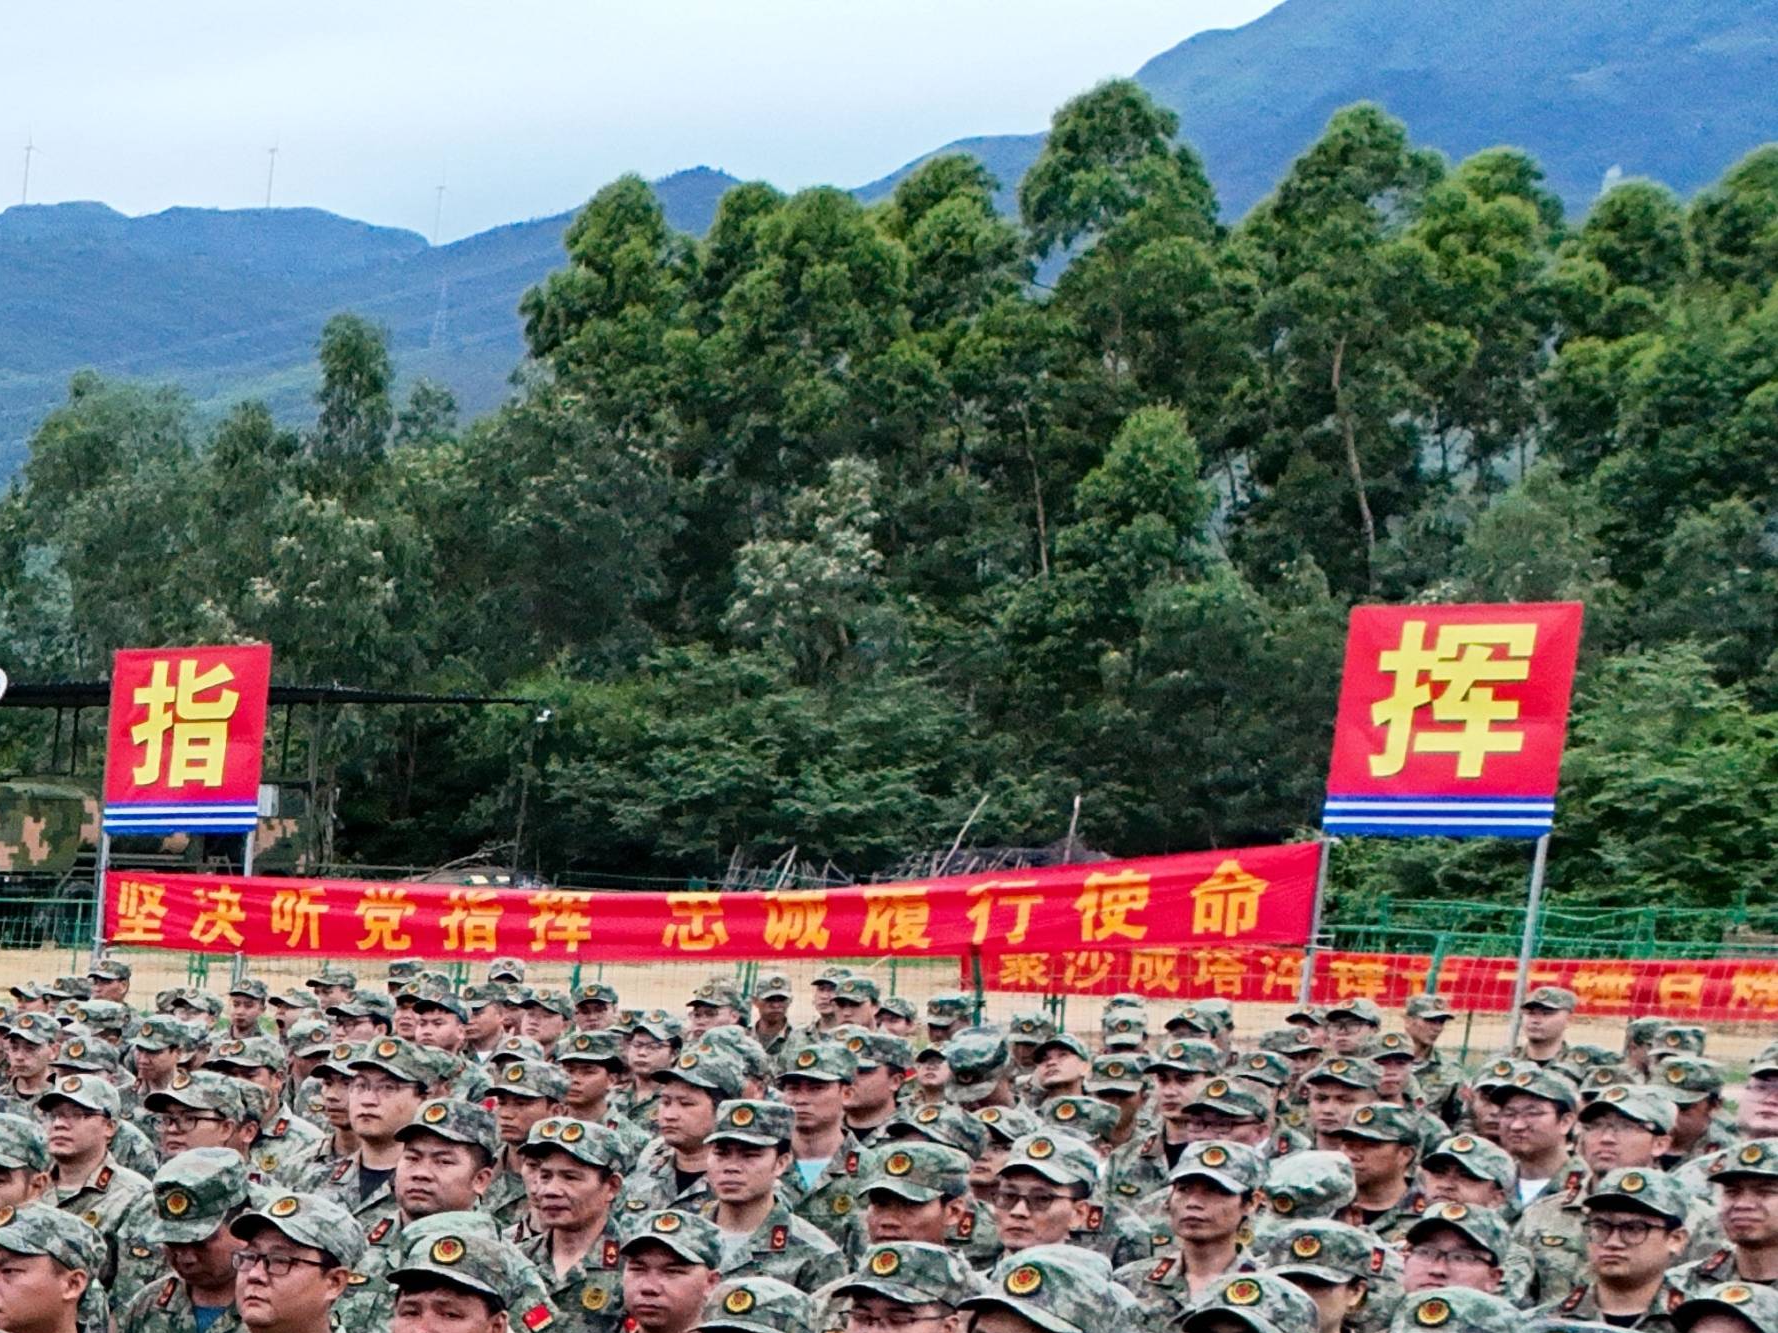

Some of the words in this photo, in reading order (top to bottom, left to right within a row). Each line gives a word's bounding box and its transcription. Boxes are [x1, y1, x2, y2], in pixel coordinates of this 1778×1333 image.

[130, 658, 240, 788] 指
[1369, 619, 1537, 779] 挥
[113, 880, 592, 952] 坚决听党指挥
[662, 859, 1270, 951] 忠诚履行使命
